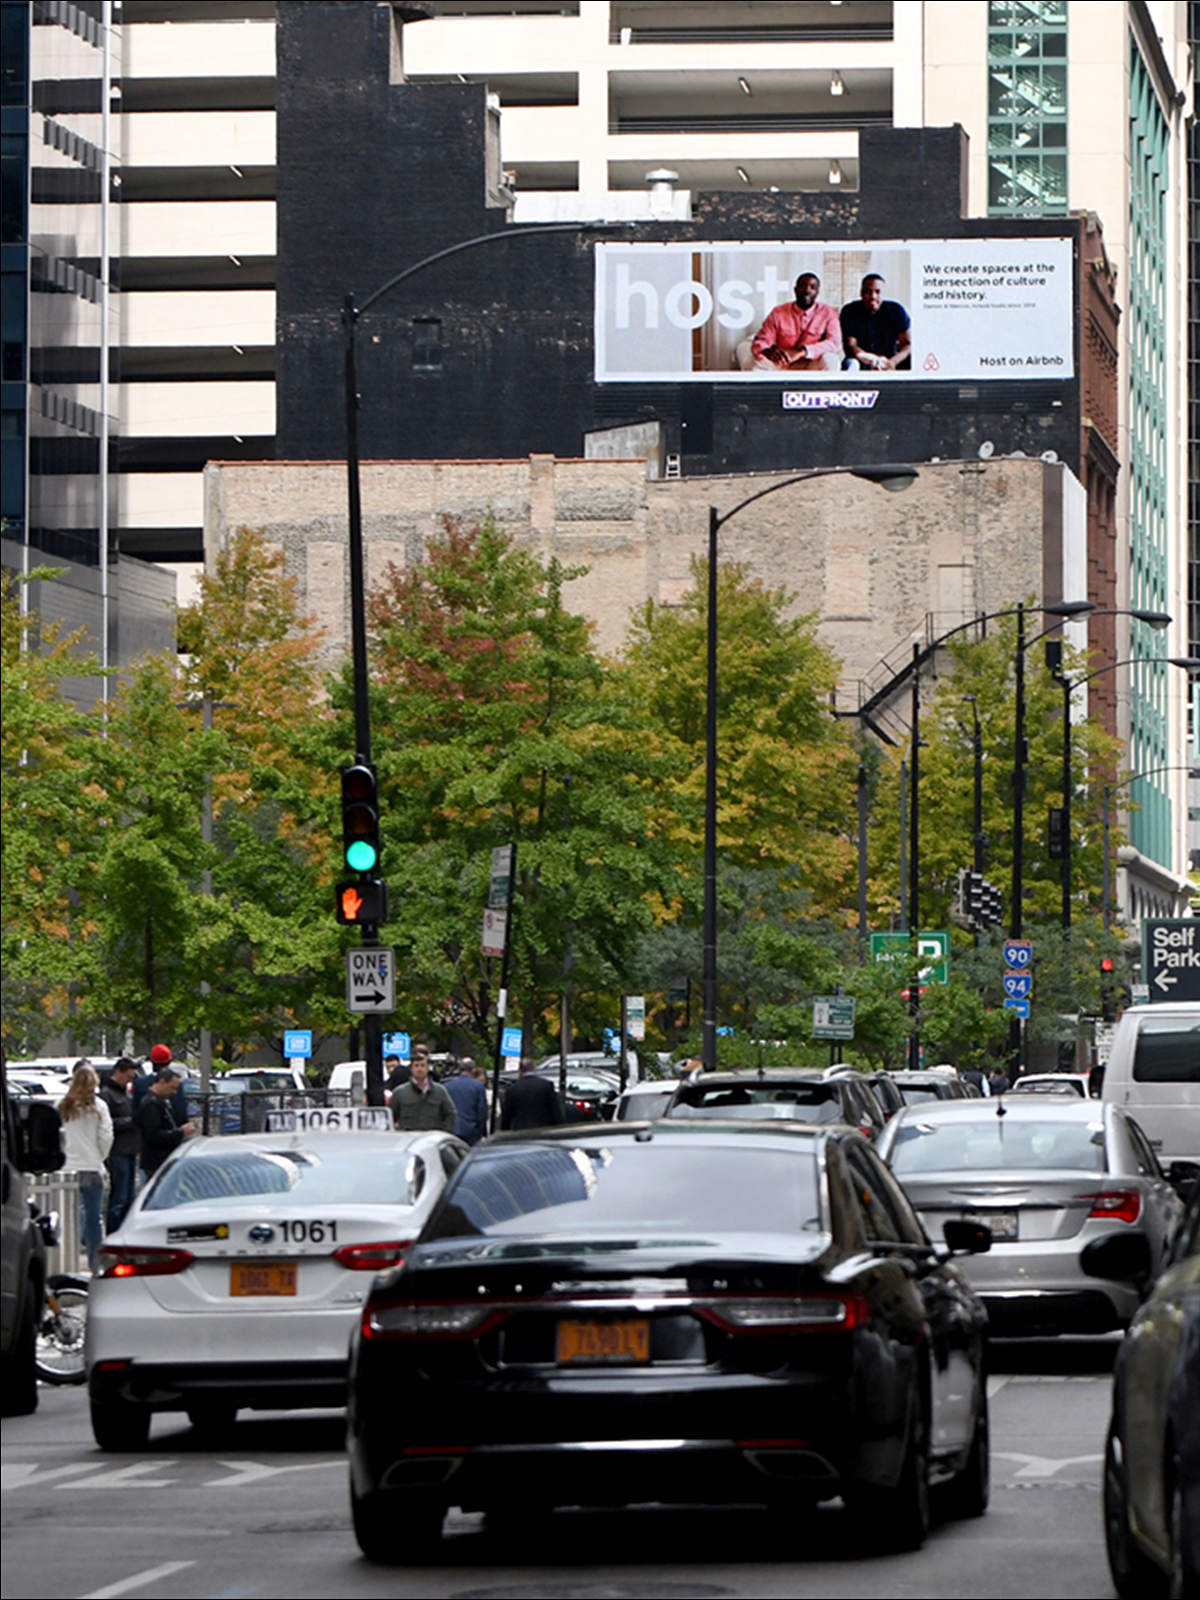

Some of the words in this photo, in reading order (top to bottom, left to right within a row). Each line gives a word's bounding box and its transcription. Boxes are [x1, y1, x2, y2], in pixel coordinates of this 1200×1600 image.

[923, 264, 941, 274] We
[943, 264, 979, 274] create
[982, 264, 1021, 275] spaces
[1023, 263, 1034, 273] at
[1036, 263, 1055, 273] the
[923, 277, 990, 287] intersection
[992, 277, 1004, 287] of
[1006, 276, 1046, 287] culture
[615, 263, 790, 330] host
[923, 290, 943, 300] and
[946, 290, 987, 301] history.
[979, 356, 1006, 366] Host
[1009, 357, 1023, 366] on
[1026, 356, 1064, 366] Airbnb
[786, 393, 876, 407] OUTFRONT
[1153, 927, 1196, 947] Self
[353, 954, 387, 970] ONE
[1007, 948, 1029, 964] 90
[352, 972, 388, 987] WAY
[1006, 979, 1026, 993] 94
[296, 1110, 355, 1130] 1061
[278, 1220, 338, 1242] 1061
